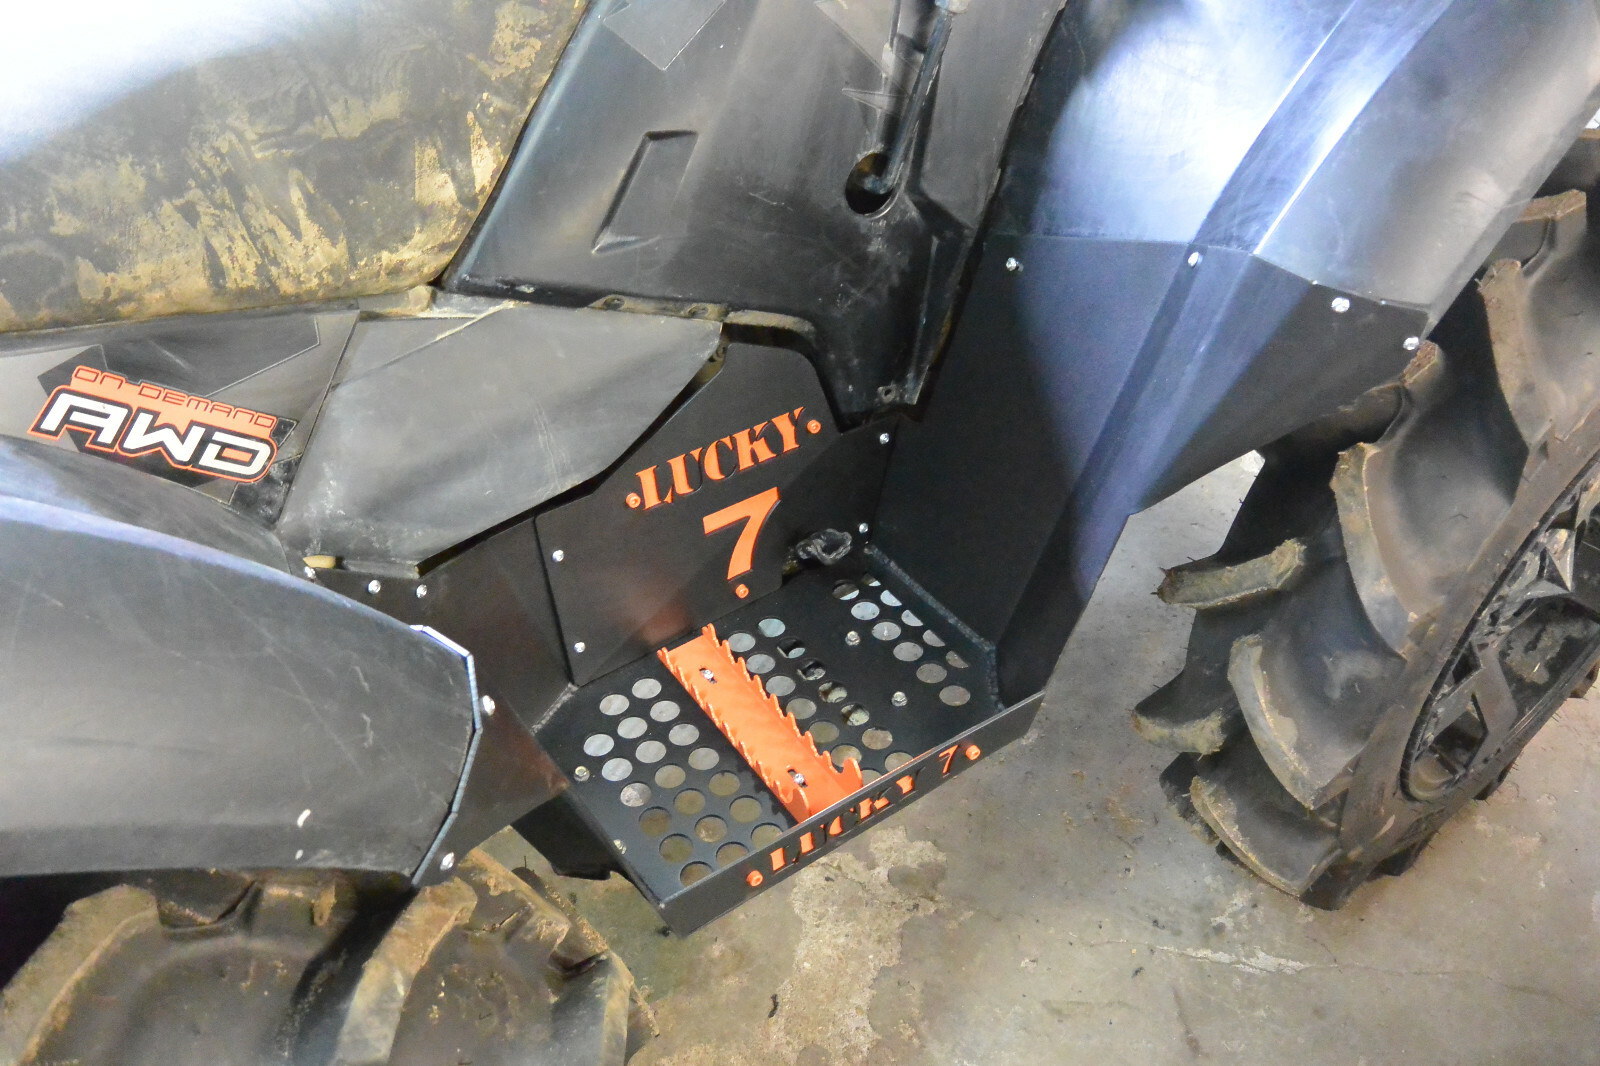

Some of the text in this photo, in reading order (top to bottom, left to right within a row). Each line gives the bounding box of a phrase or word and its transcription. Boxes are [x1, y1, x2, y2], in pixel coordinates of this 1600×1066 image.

[40, 392, 272, 475] AWD
[138, 384, 276, 427] DEMAND
[635, 406, 806, 511] LUCKY
[702, 486, 781, 581] 7
[938, 744, 960, 775] 7
